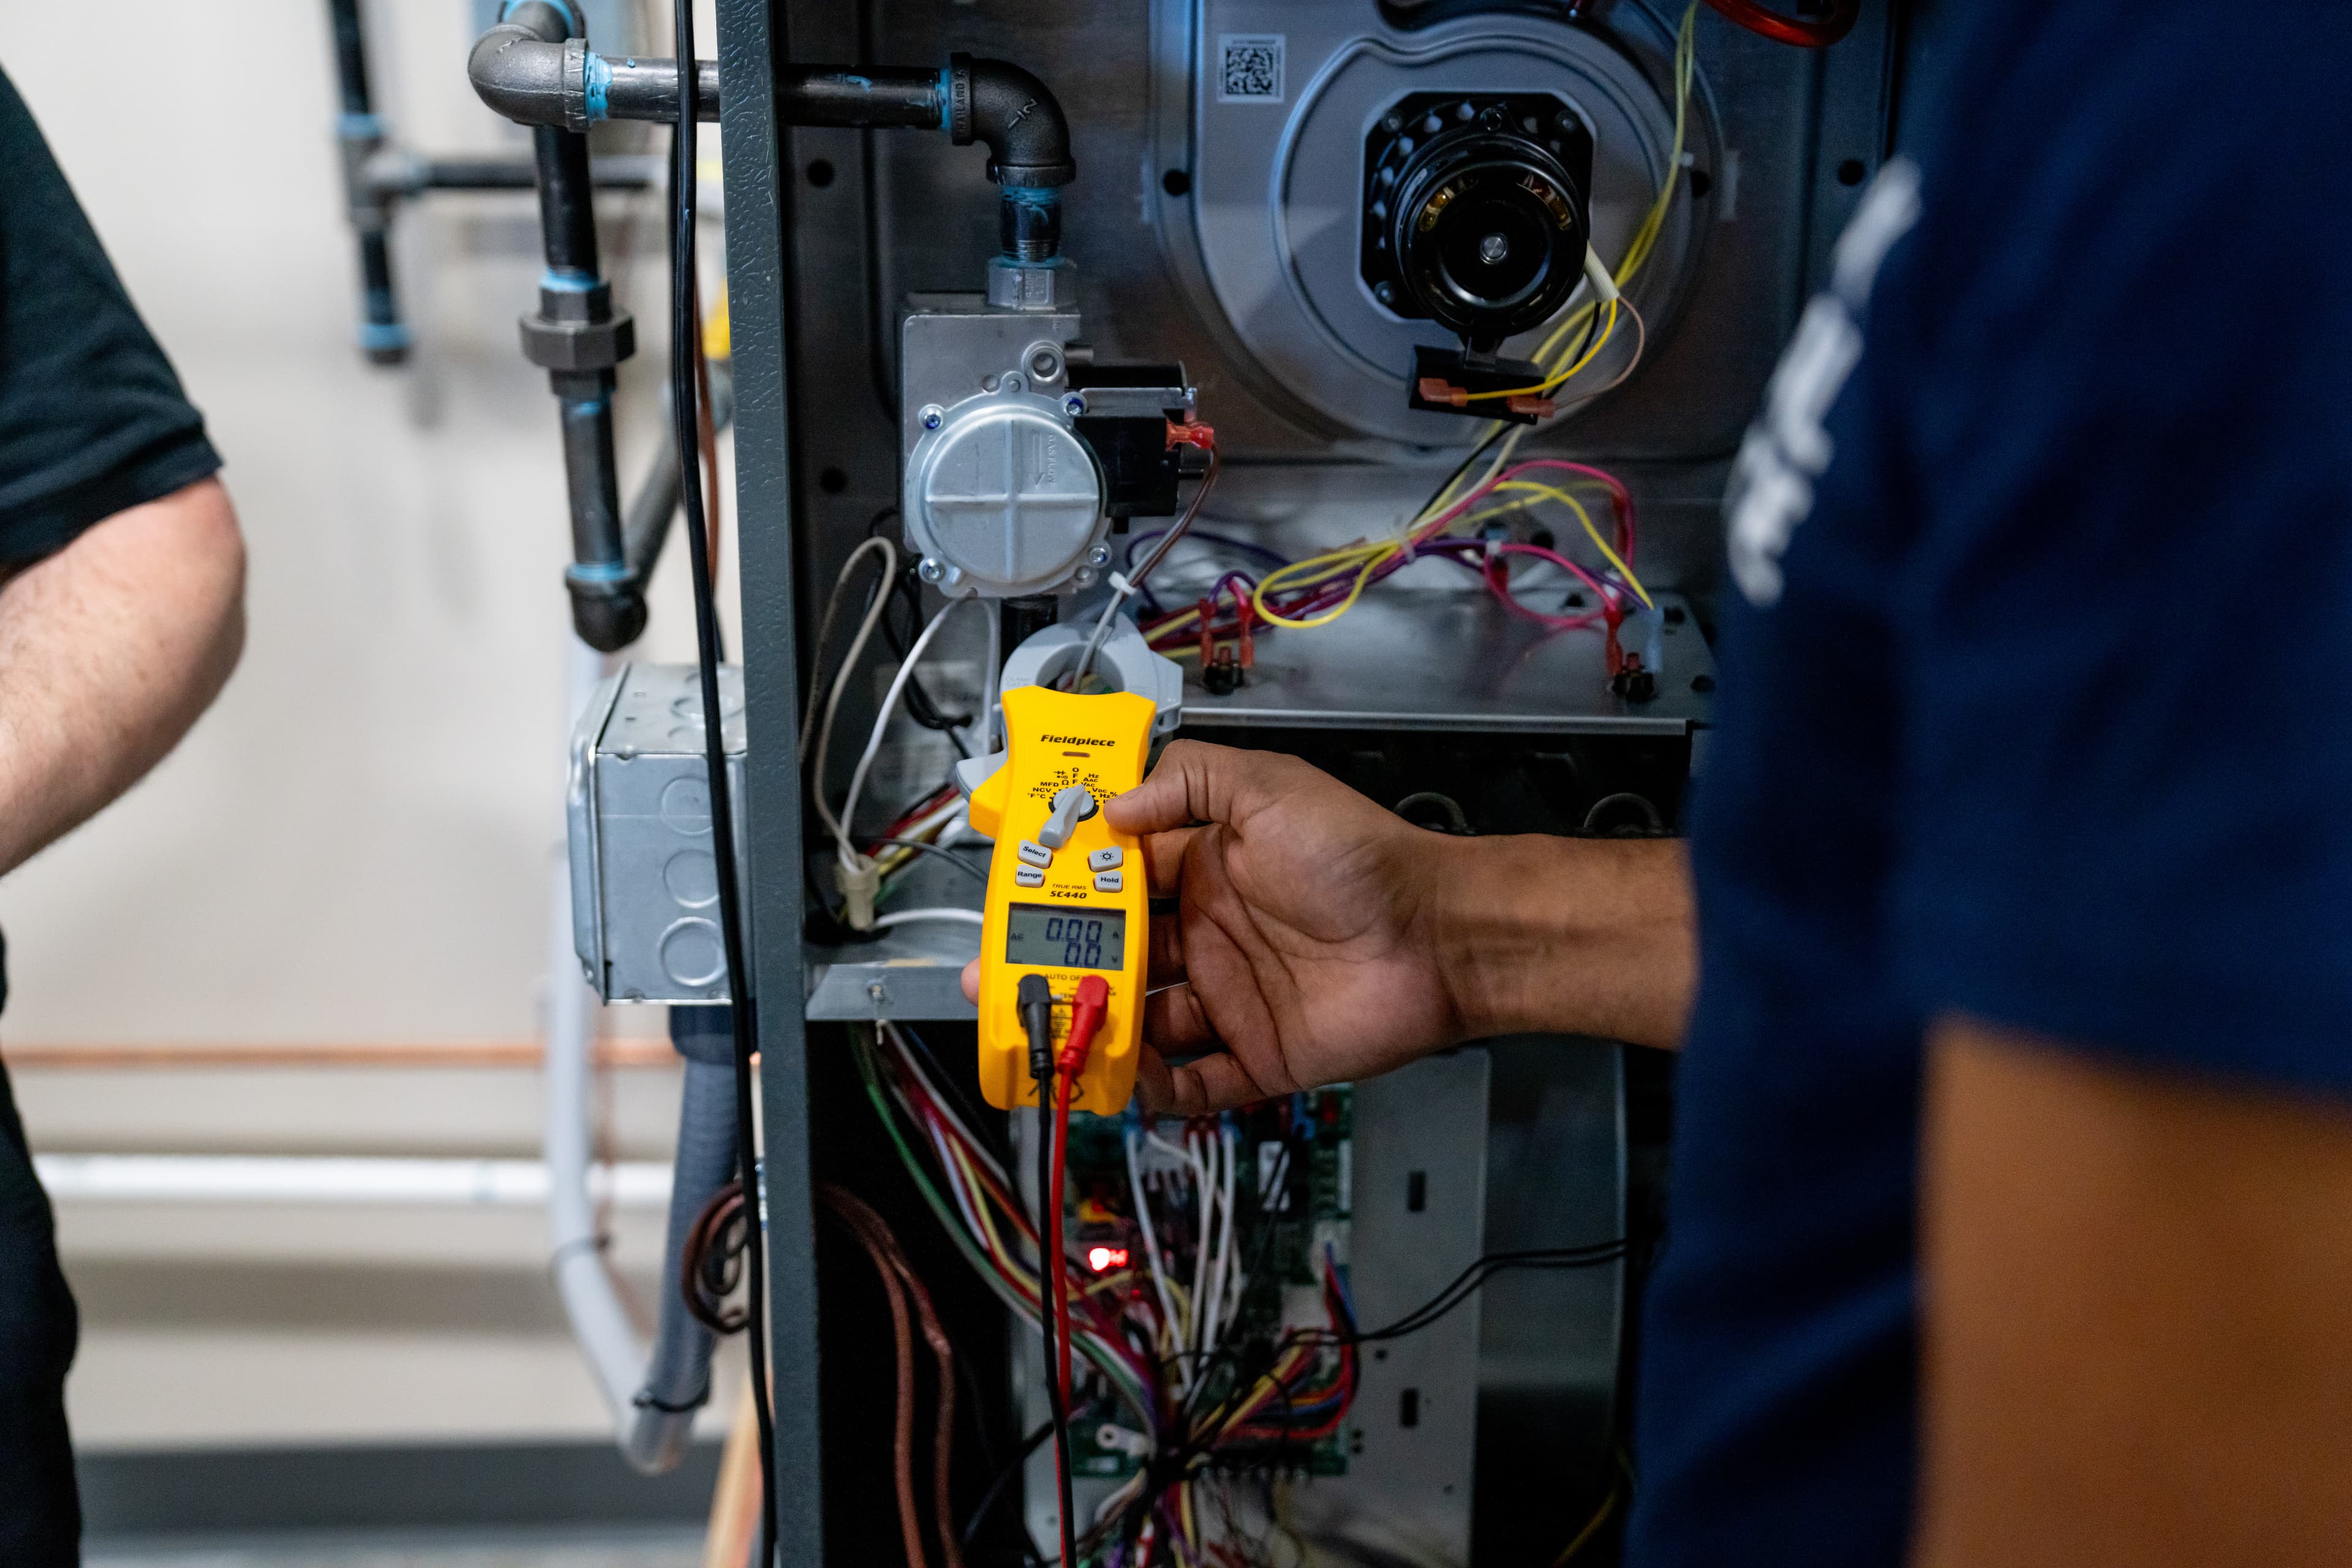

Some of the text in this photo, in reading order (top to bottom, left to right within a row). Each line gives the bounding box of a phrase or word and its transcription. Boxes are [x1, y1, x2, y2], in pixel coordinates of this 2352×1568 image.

[1040, 734, 1115, 747] Fieldpiece
[1023, 845, 1046, 858] Select
[1049, 891, 1087, 899] SC440
[1046, 918, 1102, 943] 0.00
[1064, 942, 1101, 967] 0.0
